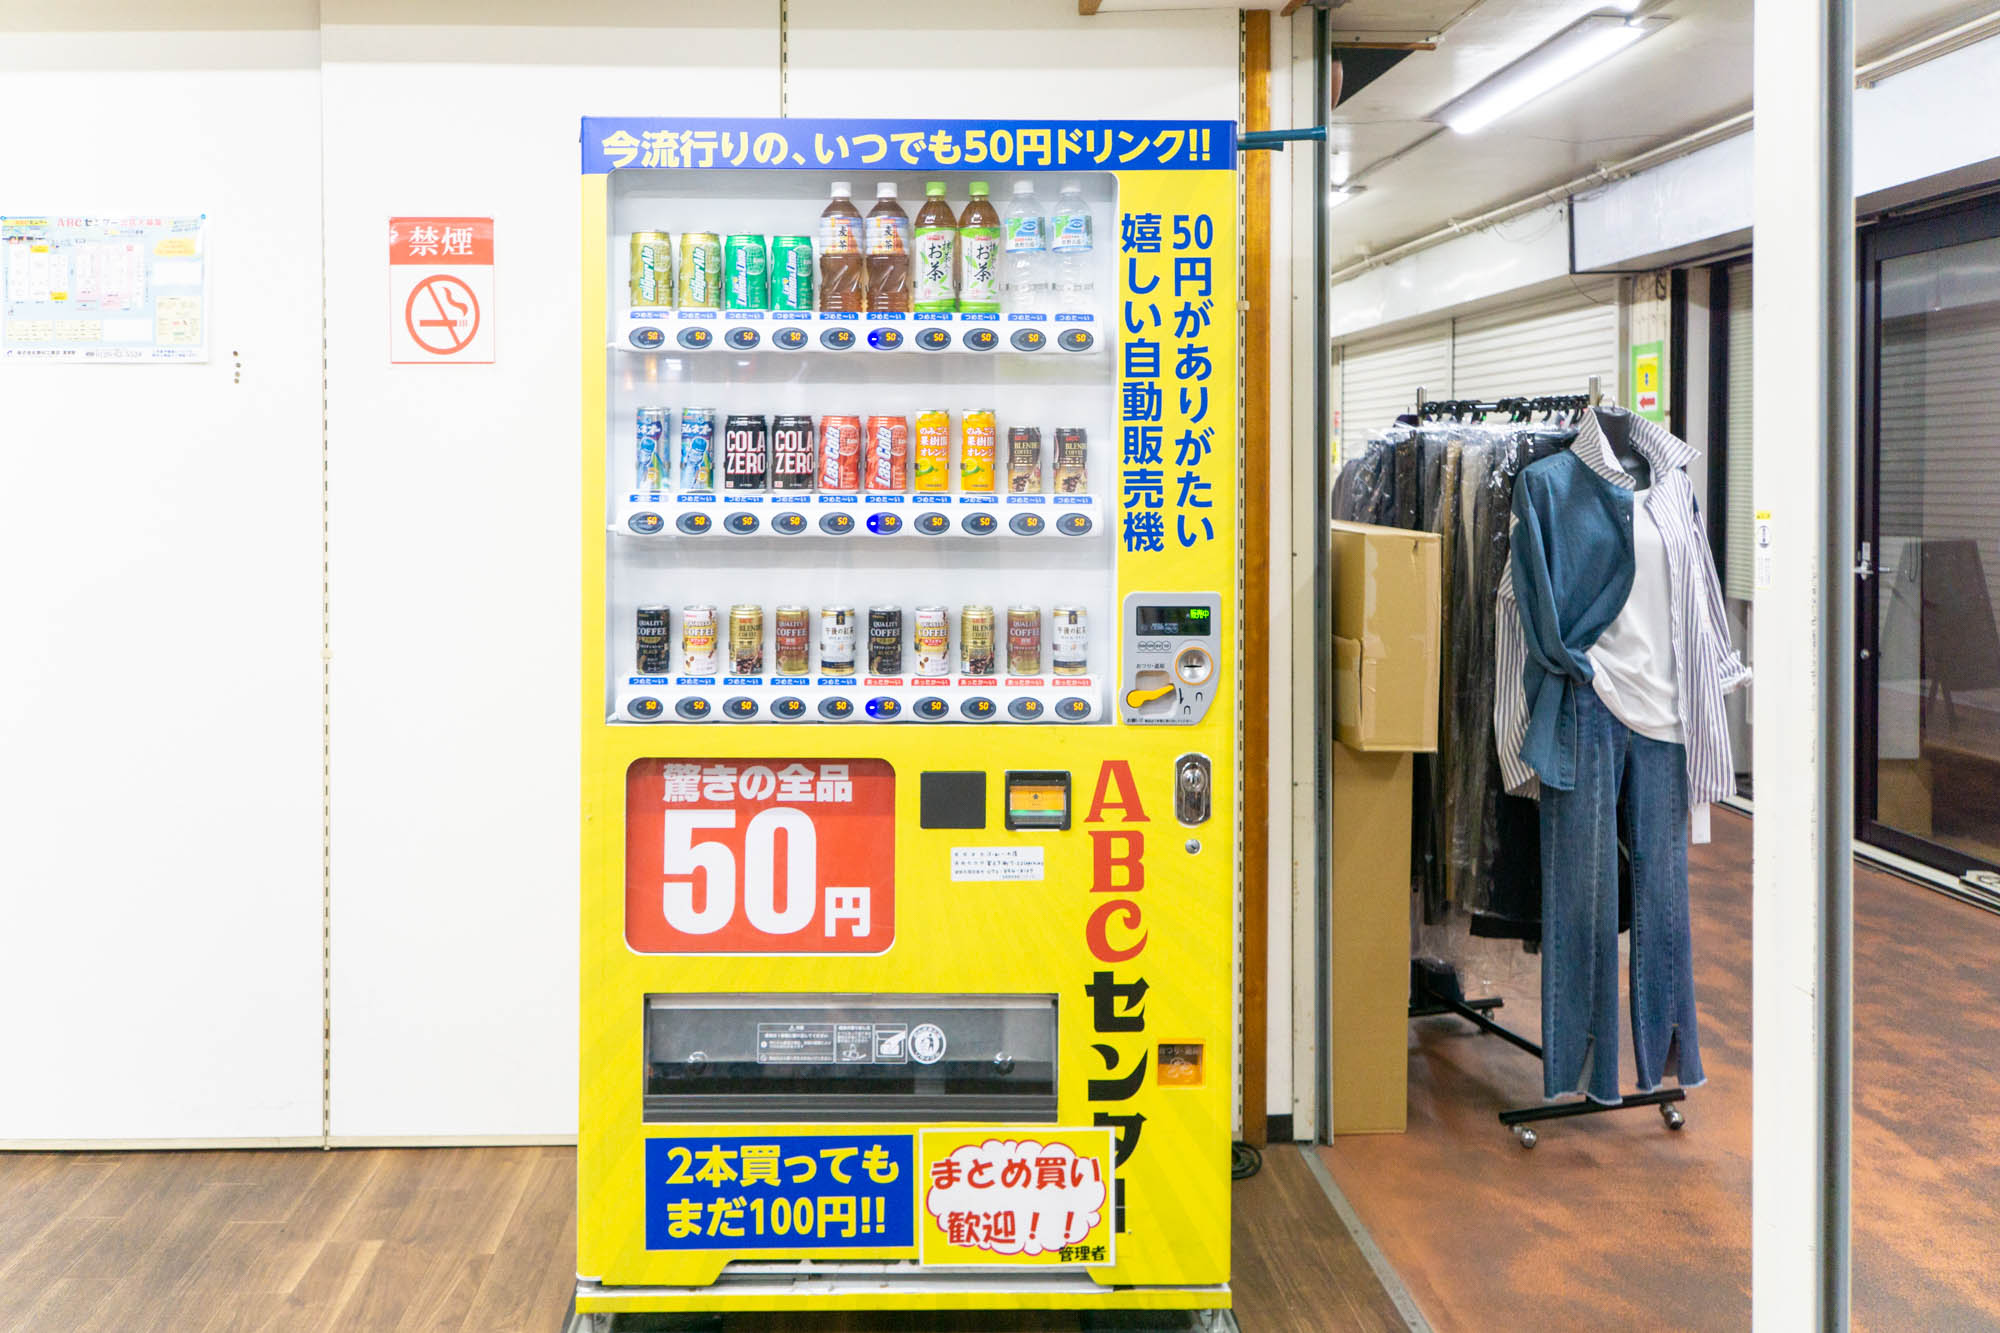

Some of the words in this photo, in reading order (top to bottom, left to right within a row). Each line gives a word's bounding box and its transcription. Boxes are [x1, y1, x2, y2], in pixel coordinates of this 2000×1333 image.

[601, 127, 1212, 168] 今流行りの、いつでも50円ドリンク!!
[408, 226, 474, 257] 禁煙
[927, 243, 944, 281] お茶
[974, 243, 991, 282] お茶
[647, 331, 659, 341] 50
[695, 331, 706, 341] 50
[743, 331, 754, 340] 50
[790, 332, 801, 341] 50
[838, 332, 849, 341] 50
[885, 332, 897, 342] 50
[933, 333, 944, 342] 50
[981, 333, 992, 342] 50
[1028, 333, 1039, 343] 50
[1075, 333, 1087, 343] 50
[1121, 212, 1165, 553] 嬉しい自動販売機
[1171, 213, 1215, 548] 50円がありがたい
[727, 430, 766, 452] COLA
[775, 430, 814, 452] COLA
[727, 453, 766, 474] ZERO
[775, 453, 814, 474] ZERO
[647, 516, 658, 525] 50
[694, 516, 706, 526] 50
[742, 516, 753, 526] 50
[789, 516, 801, 526] 50
[837, 516, 848, 526] 50
[884, 516, 896, 526] 50
[932, 517, 943, 526] 50
[980, 517, 991, 526] 50
[1026, 517, 1038, 527] 50
[1074, 517, 1085, 527] 50
[645, 700, 657, 710] 50
[693, 701, 705, 710] 50
[741, 701, 753, 710] 50
[789, 701, 800, 710] 50
[836, 701, 847, 710] 50
[884, 701, 895, 710] 50
[931, 701, 942, 710] 50
[978, 701, 989, 711] 50
[1025, 701, 1037, 711] 50
[1073, 701, 1084, 711] 50
[662, 763, 853, 803] 驚きの全品
[662, 806, 871, 938] 50円
[666, 1144, 900, 1189] 2本買っても
[930, 1155, 1102, 1191] まとめ買い
[666, 1195, 887, 1238] まだ100円!!
[1057, 1245, 1107, 1263] 管理者
